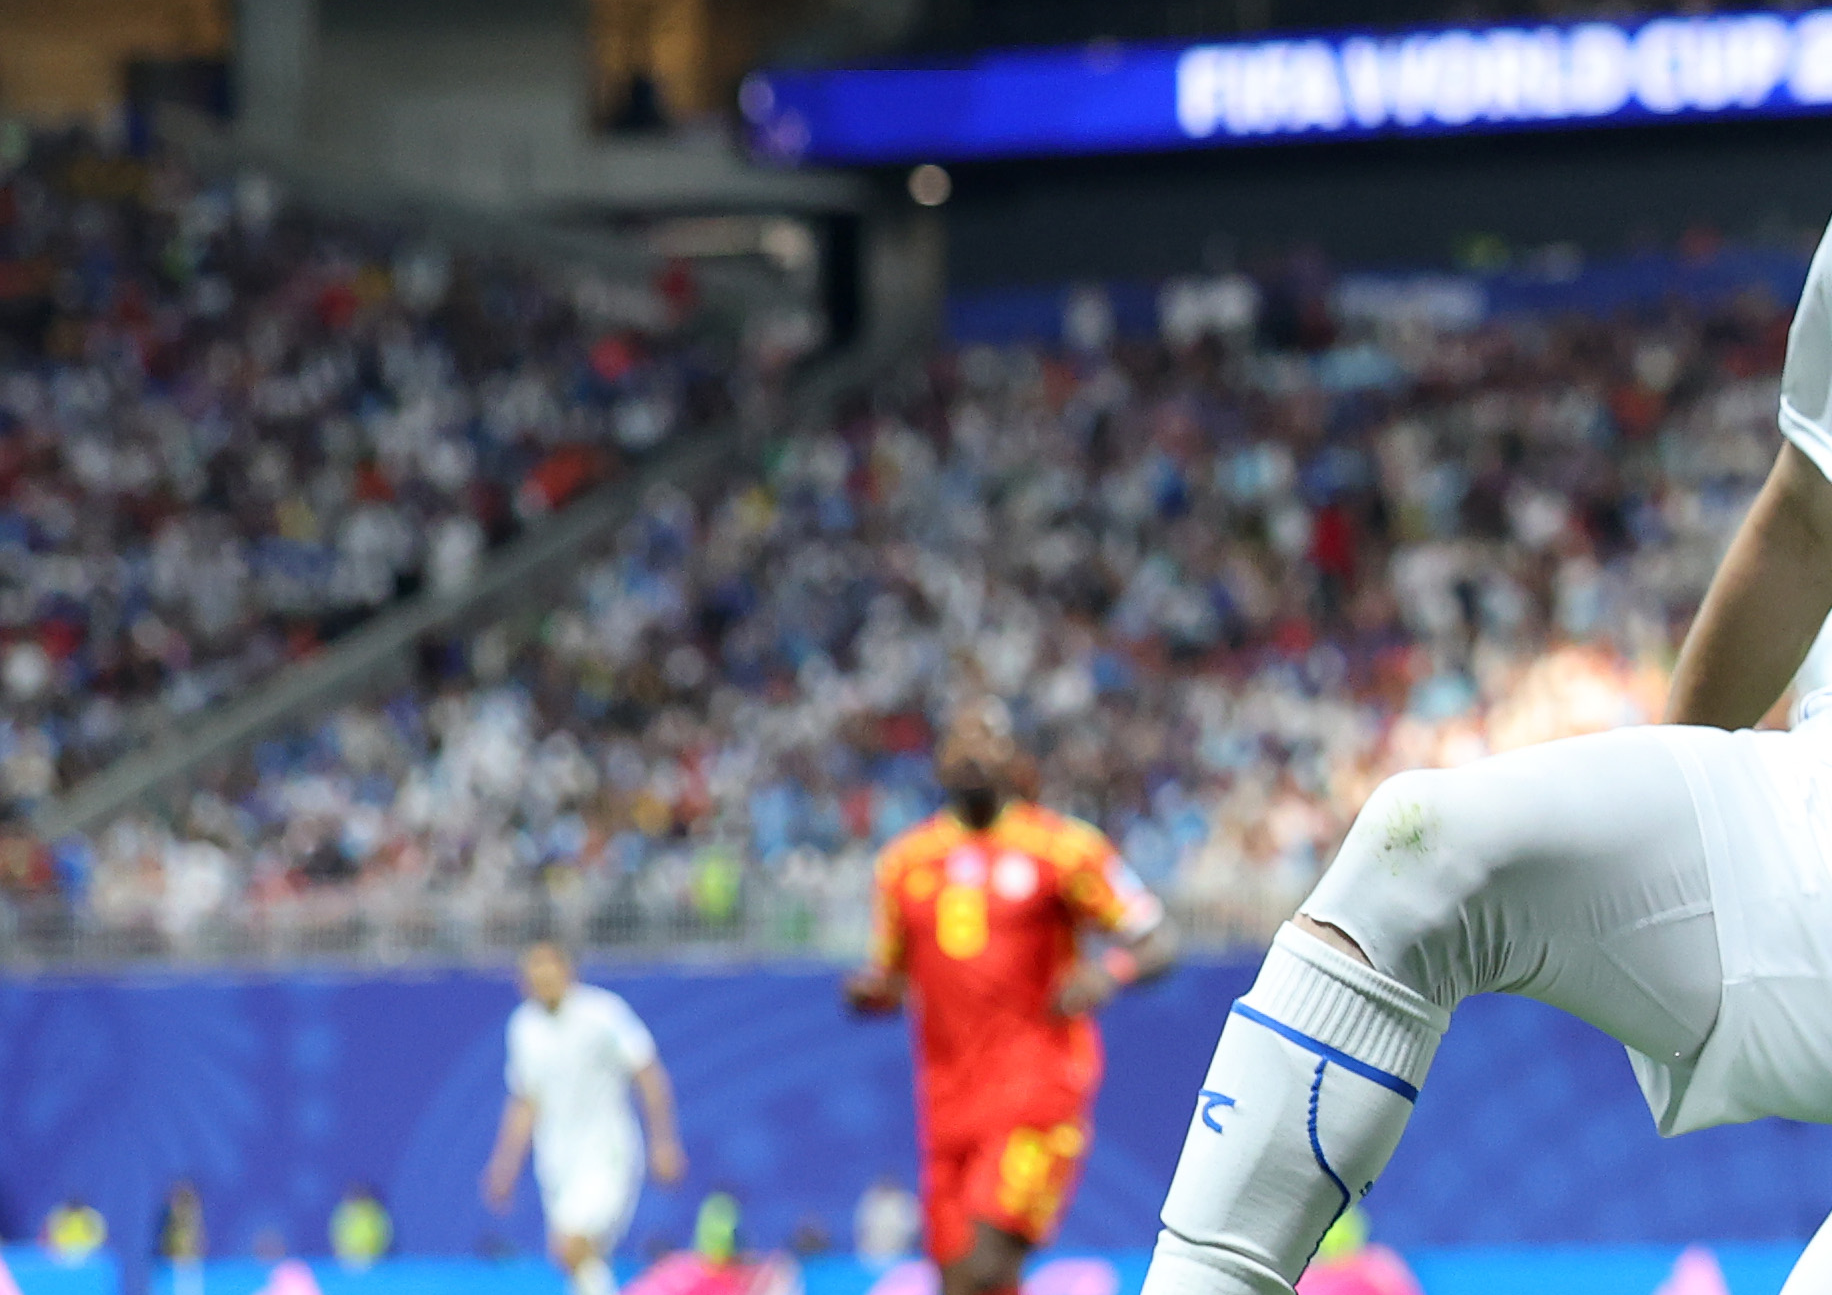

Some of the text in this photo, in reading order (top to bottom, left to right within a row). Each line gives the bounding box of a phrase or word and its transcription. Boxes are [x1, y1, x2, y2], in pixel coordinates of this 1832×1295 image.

[1177, 41, 1344, 138] FIFA
[1343, 20, 1631, 130] WORLD
[1630, 13, 1792, 114] CUP
